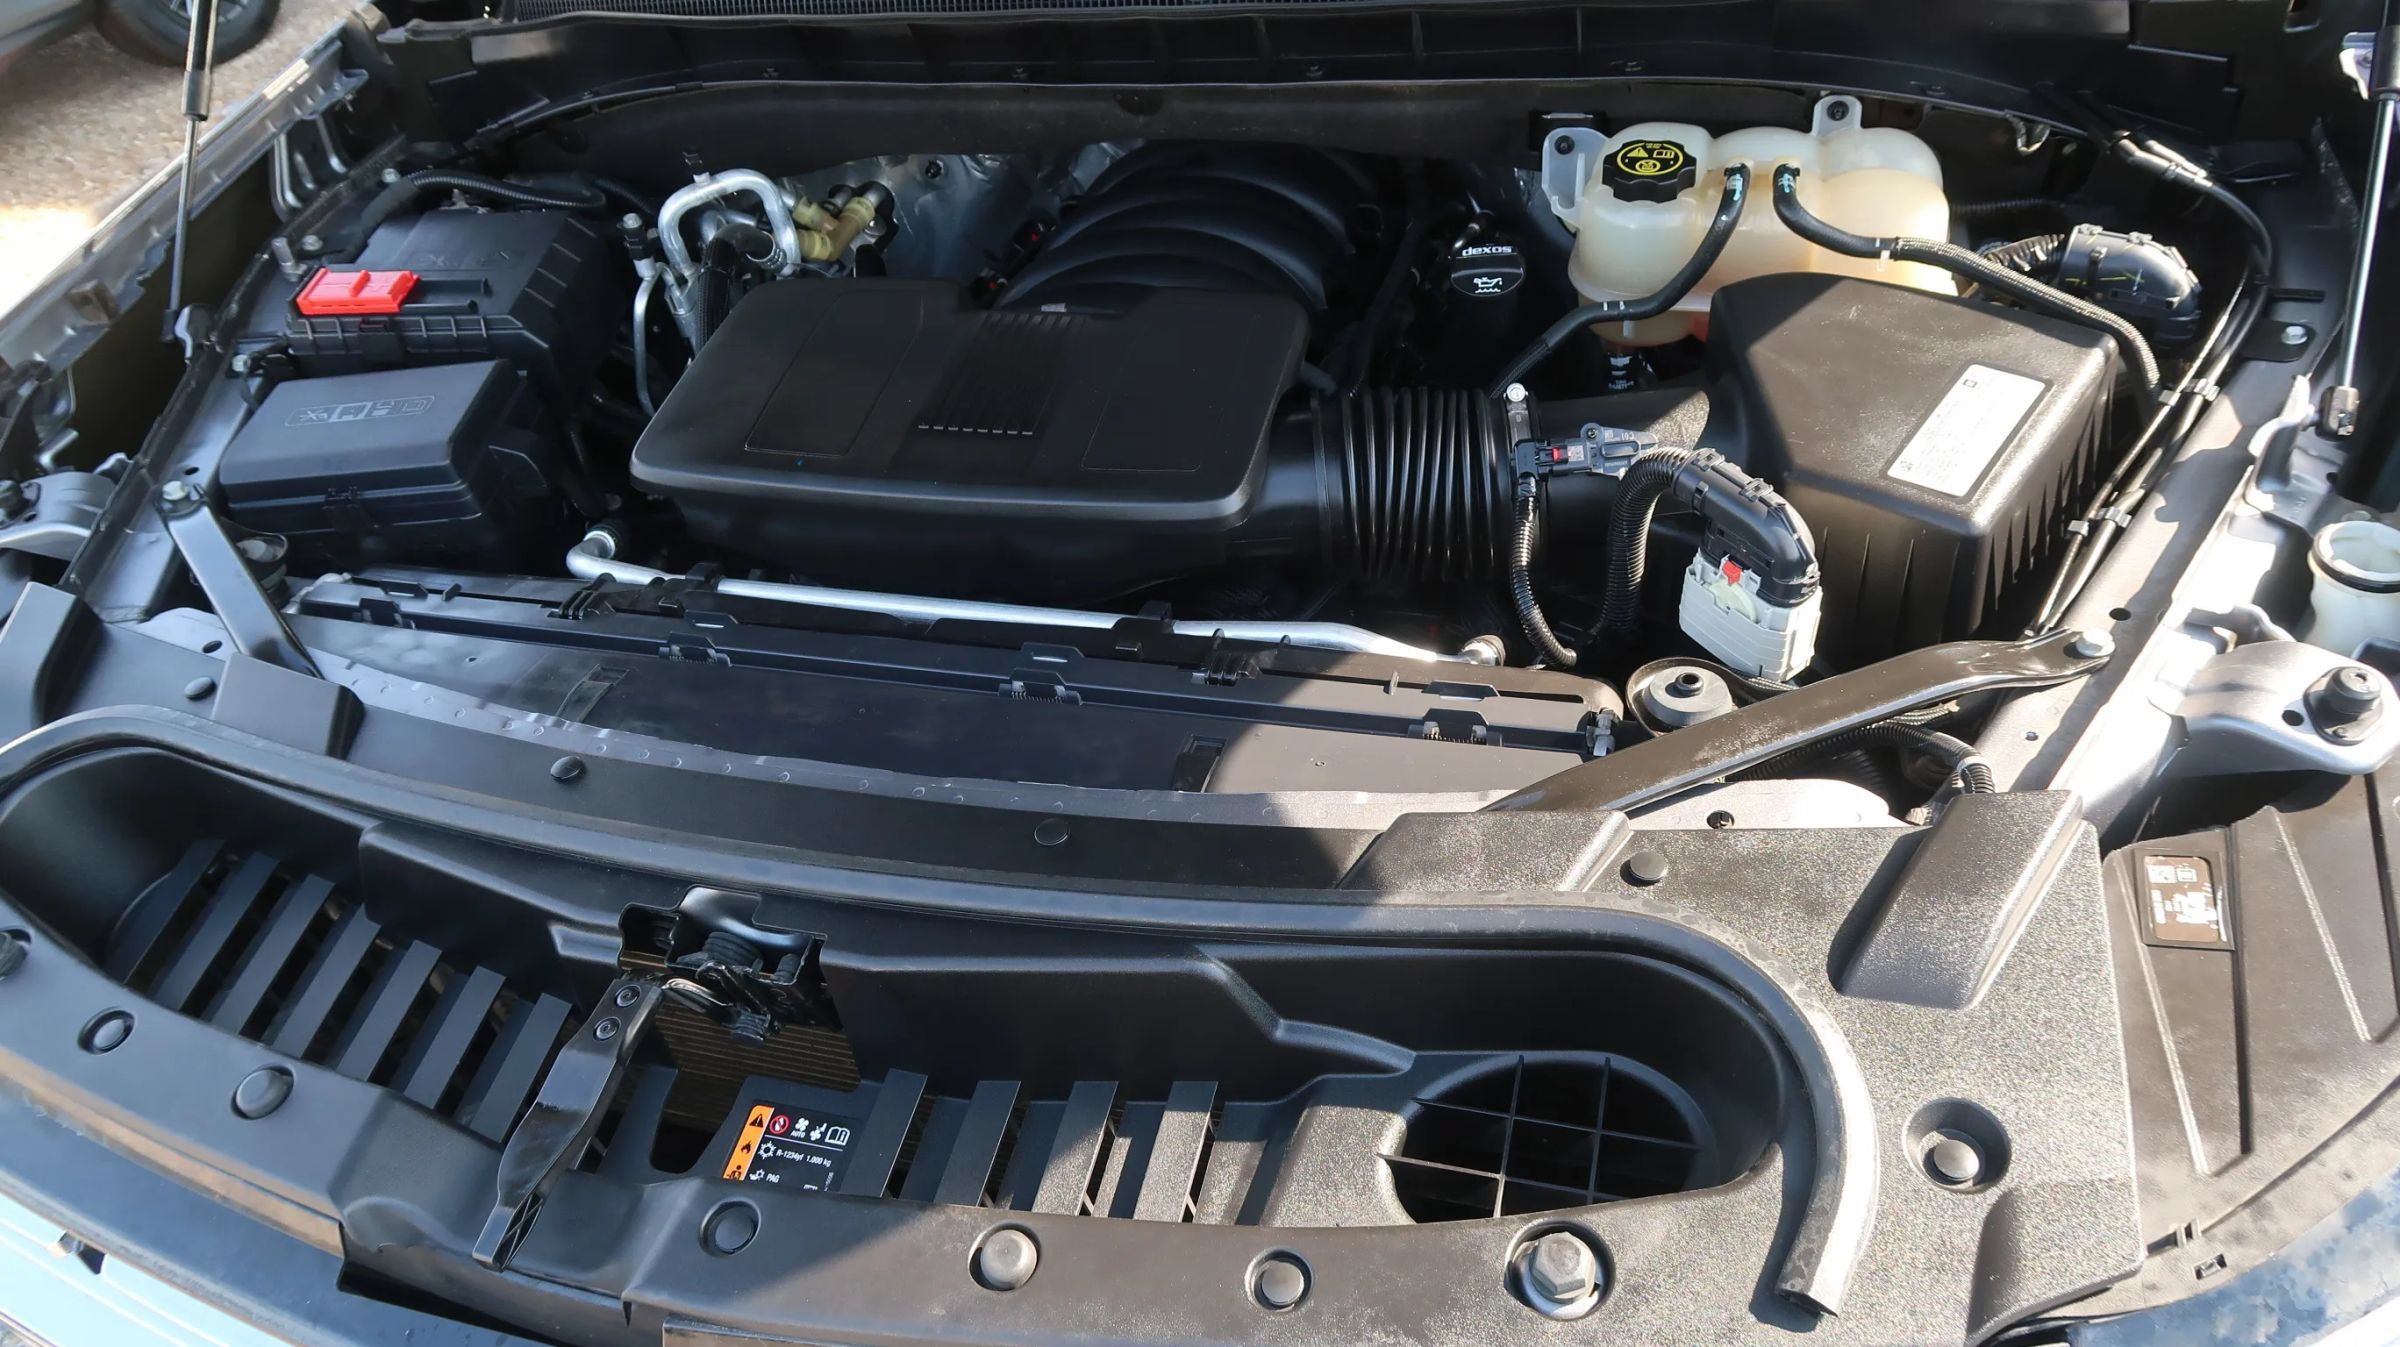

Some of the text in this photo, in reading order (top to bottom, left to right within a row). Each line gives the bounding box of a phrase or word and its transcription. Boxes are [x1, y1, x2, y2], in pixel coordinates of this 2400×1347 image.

[1462, 246, 1511, 256] dexos
[776, 1149, 804, 1161] R-1234yf
[823, 1158, 831, 1167] kg
[766, 1173, 780, 1183] PAG
